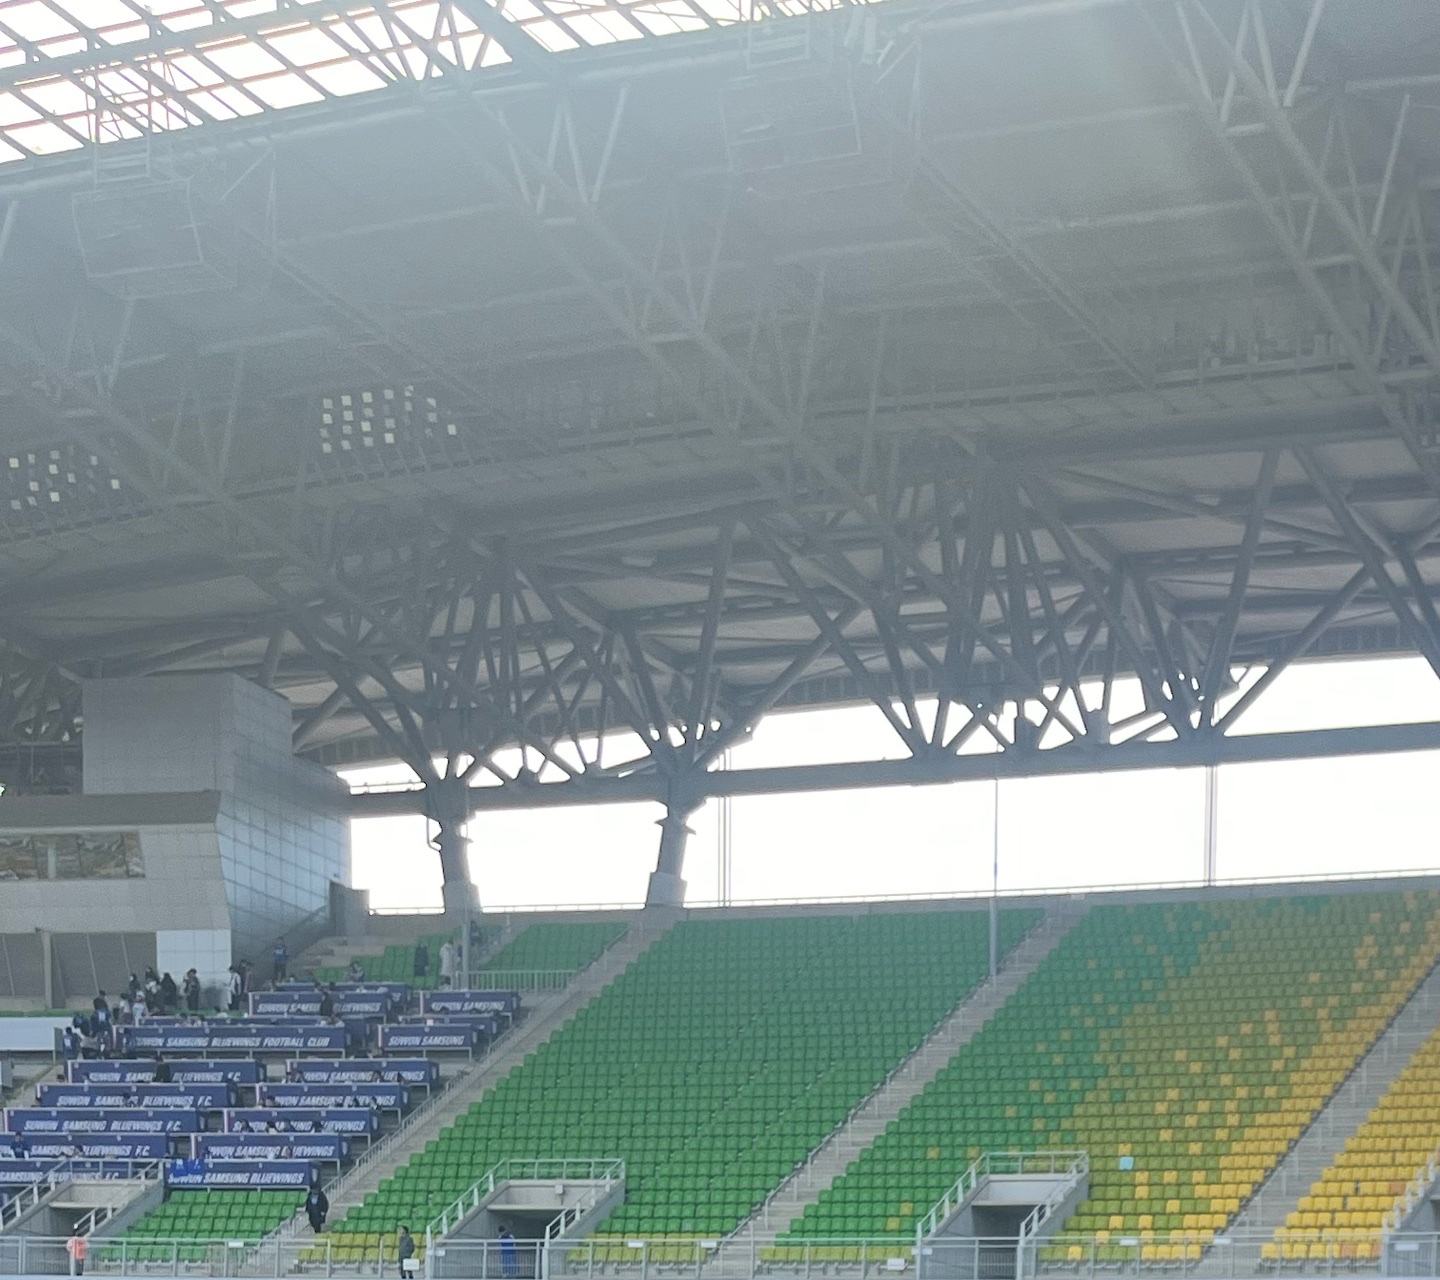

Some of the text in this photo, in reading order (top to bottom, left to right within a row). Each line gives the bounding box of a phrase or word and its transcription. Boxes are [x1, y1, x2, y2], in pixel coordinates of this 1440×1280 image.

[263, 1036, 304, 1047] FOOTBALL
[307, 1036, 330, 1047] CLUB
[388, 1036, 465, 1046] SUWON SAMSUNG
[62, 1120, 107, 1131] SAMSUNG
[110, 1120, 163, 1131] BLUEWINGS
[203, 1173, 249, 1184] SAMSUNG
[250, 1173, 305, 1184] BLUEWINGS
